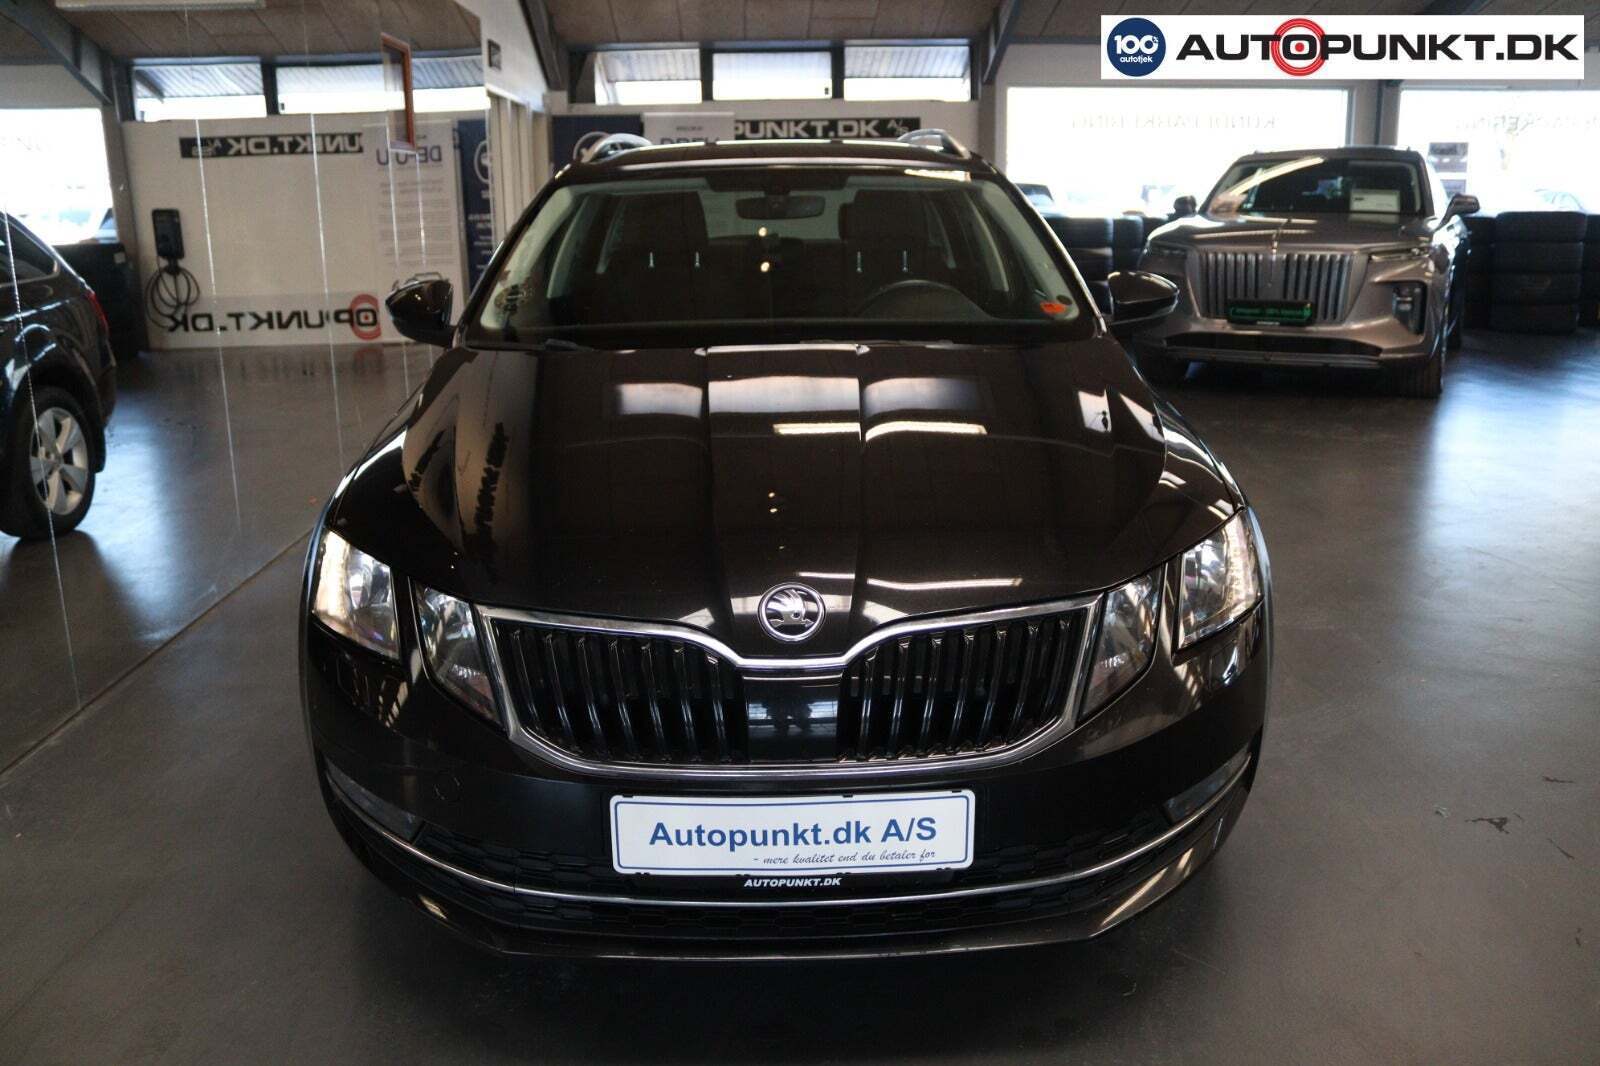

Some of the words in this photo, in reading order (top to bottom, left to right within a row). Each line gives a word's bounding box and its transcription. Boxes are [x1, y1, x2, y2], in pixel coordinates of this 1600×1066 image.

[649, 821, 872, 851] Autopunkt.dk
[881, 817, 937, 842] A/S
[763, 855, 789, 864] mere
[792, 853, 834, 864] kvalitet
[838, 852, 857, 862] end
[861, 851, 876, 861] du
[879, 850, 916, 861] betaler
[919, 849, 936, 861] for
[744, 877, 842, 888] AUTOPUNKT.DK
